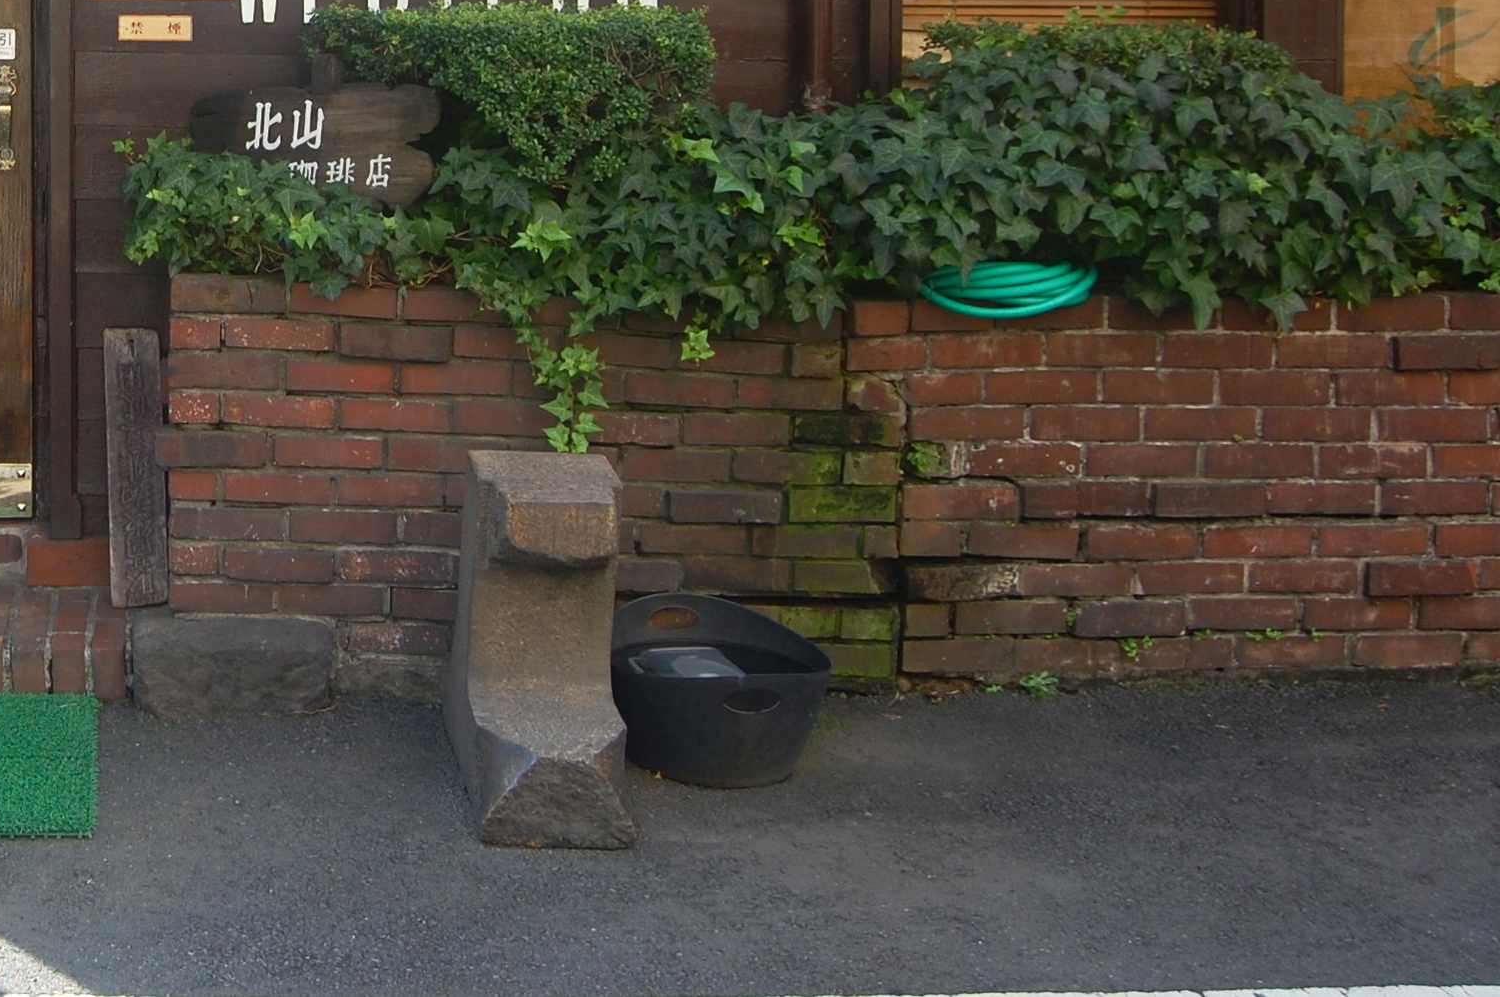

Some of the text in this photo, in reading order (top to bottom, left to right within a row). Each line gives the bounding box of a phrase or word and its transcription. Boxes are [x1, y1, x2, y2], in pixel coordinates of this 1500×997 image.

[0, 32, 11, 46] 引
[130, 21, 181, 35] 禁煙
[245, 99, 325, 151] 北山
[288, 153, 392, 187] 珈琲店
